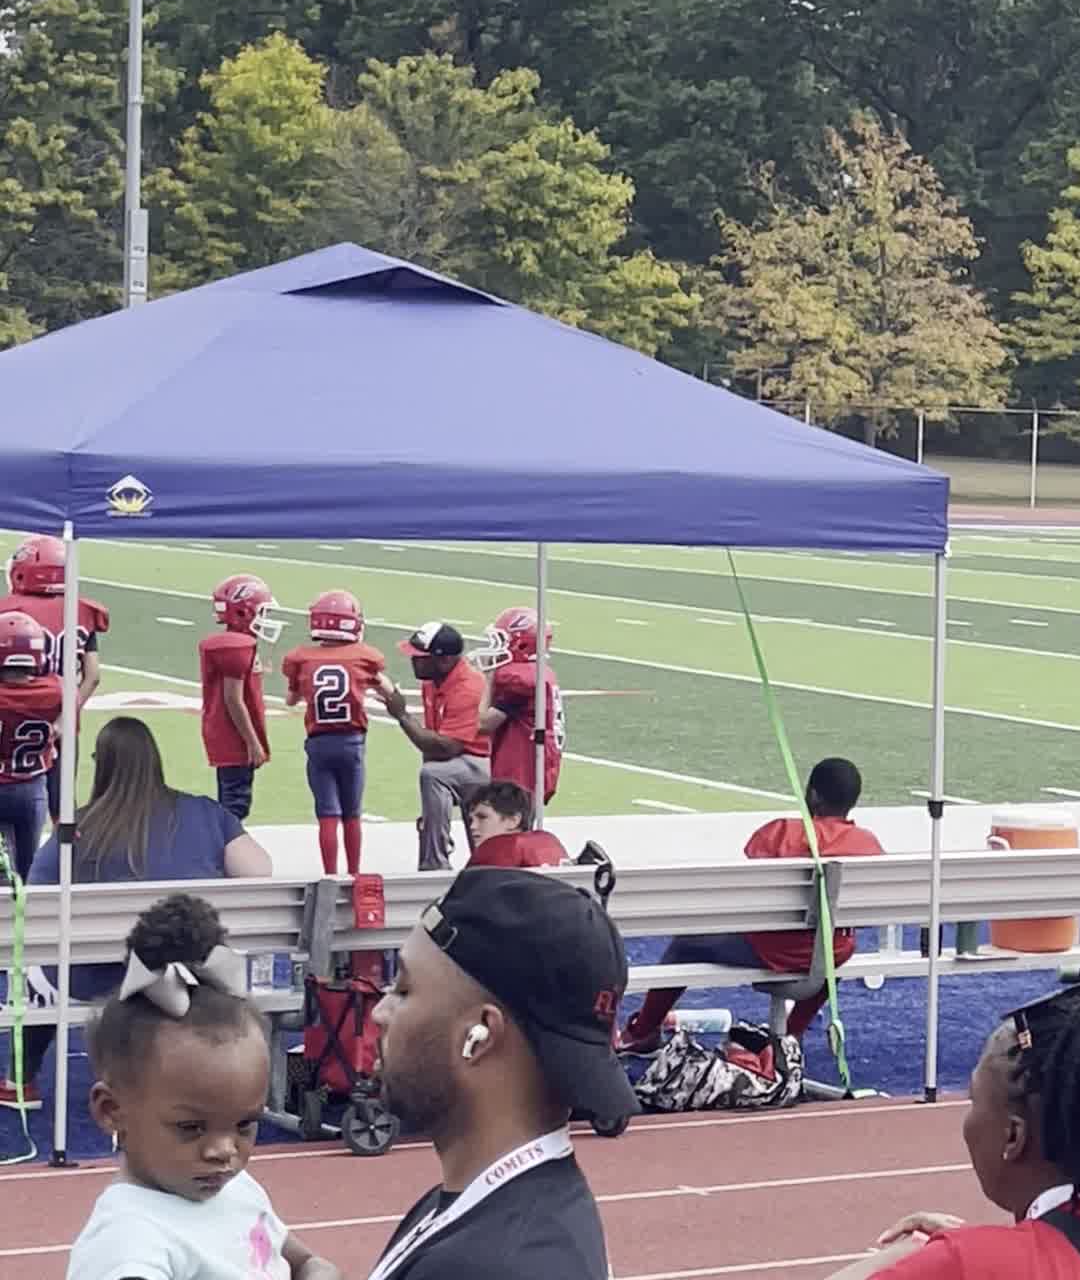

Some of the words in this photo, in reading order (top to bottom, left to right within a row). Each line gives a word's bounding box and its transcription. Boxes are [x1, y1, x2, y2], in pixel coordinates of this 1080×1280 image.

[313, 664, 351, 724] 2
[0, 719, 52, 776] 2
[485, 1143, 544, 1185] COMETS
